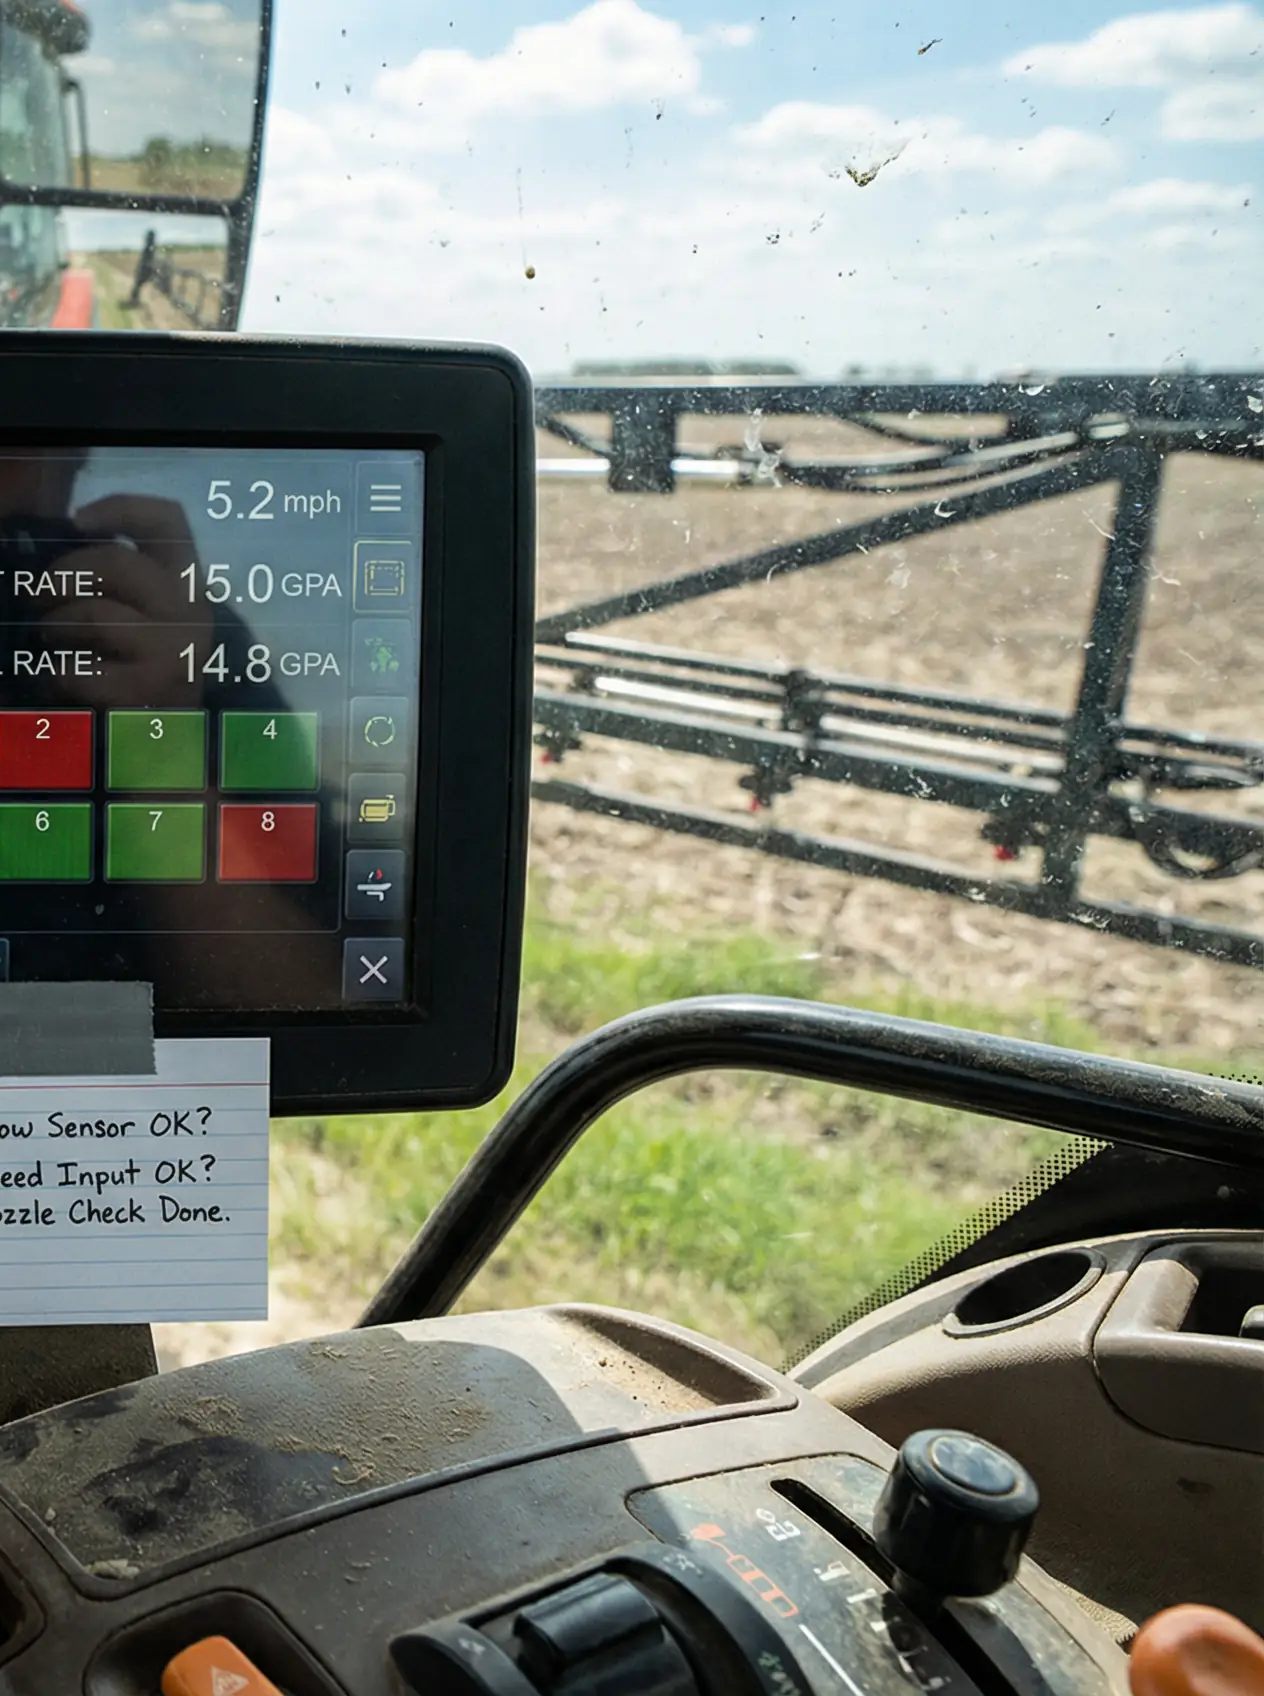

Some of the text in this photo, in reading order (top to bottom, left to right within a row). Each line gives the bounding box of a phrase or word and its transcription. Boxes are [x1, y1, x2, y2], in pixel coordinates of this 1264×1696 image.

[206, 480, 274, 520] 5.2
[284, 489, 341, 519] mph
[14, 570, 103, 597] RATE:
[181, 563, 274, 603] 15.0
[281, 573, 343, 597] GPA
[14, 650, 102, 676] RATE:
[179, 642, 272, 683] 14.8
[280, 652, 341, 676] GPA
[35, 718, 51, 739] 2
[149, 718, 164, 740] 3
[262, 719, 278, 740] 4
[35, 810, 50, 832] 6
[149, 810, 163, 831] 7
[261, 811, 275, 832] 8
[47, 1111, 136, 1139] Sensor
[149, 1106, 212, 1137] OK?
[56, 1158, 141, 1196] Input
[154, 1154, 216, 1185] OK?
[68, 1197, 146, 1225] Check
[158, 1195, 231, 1223] Done.
